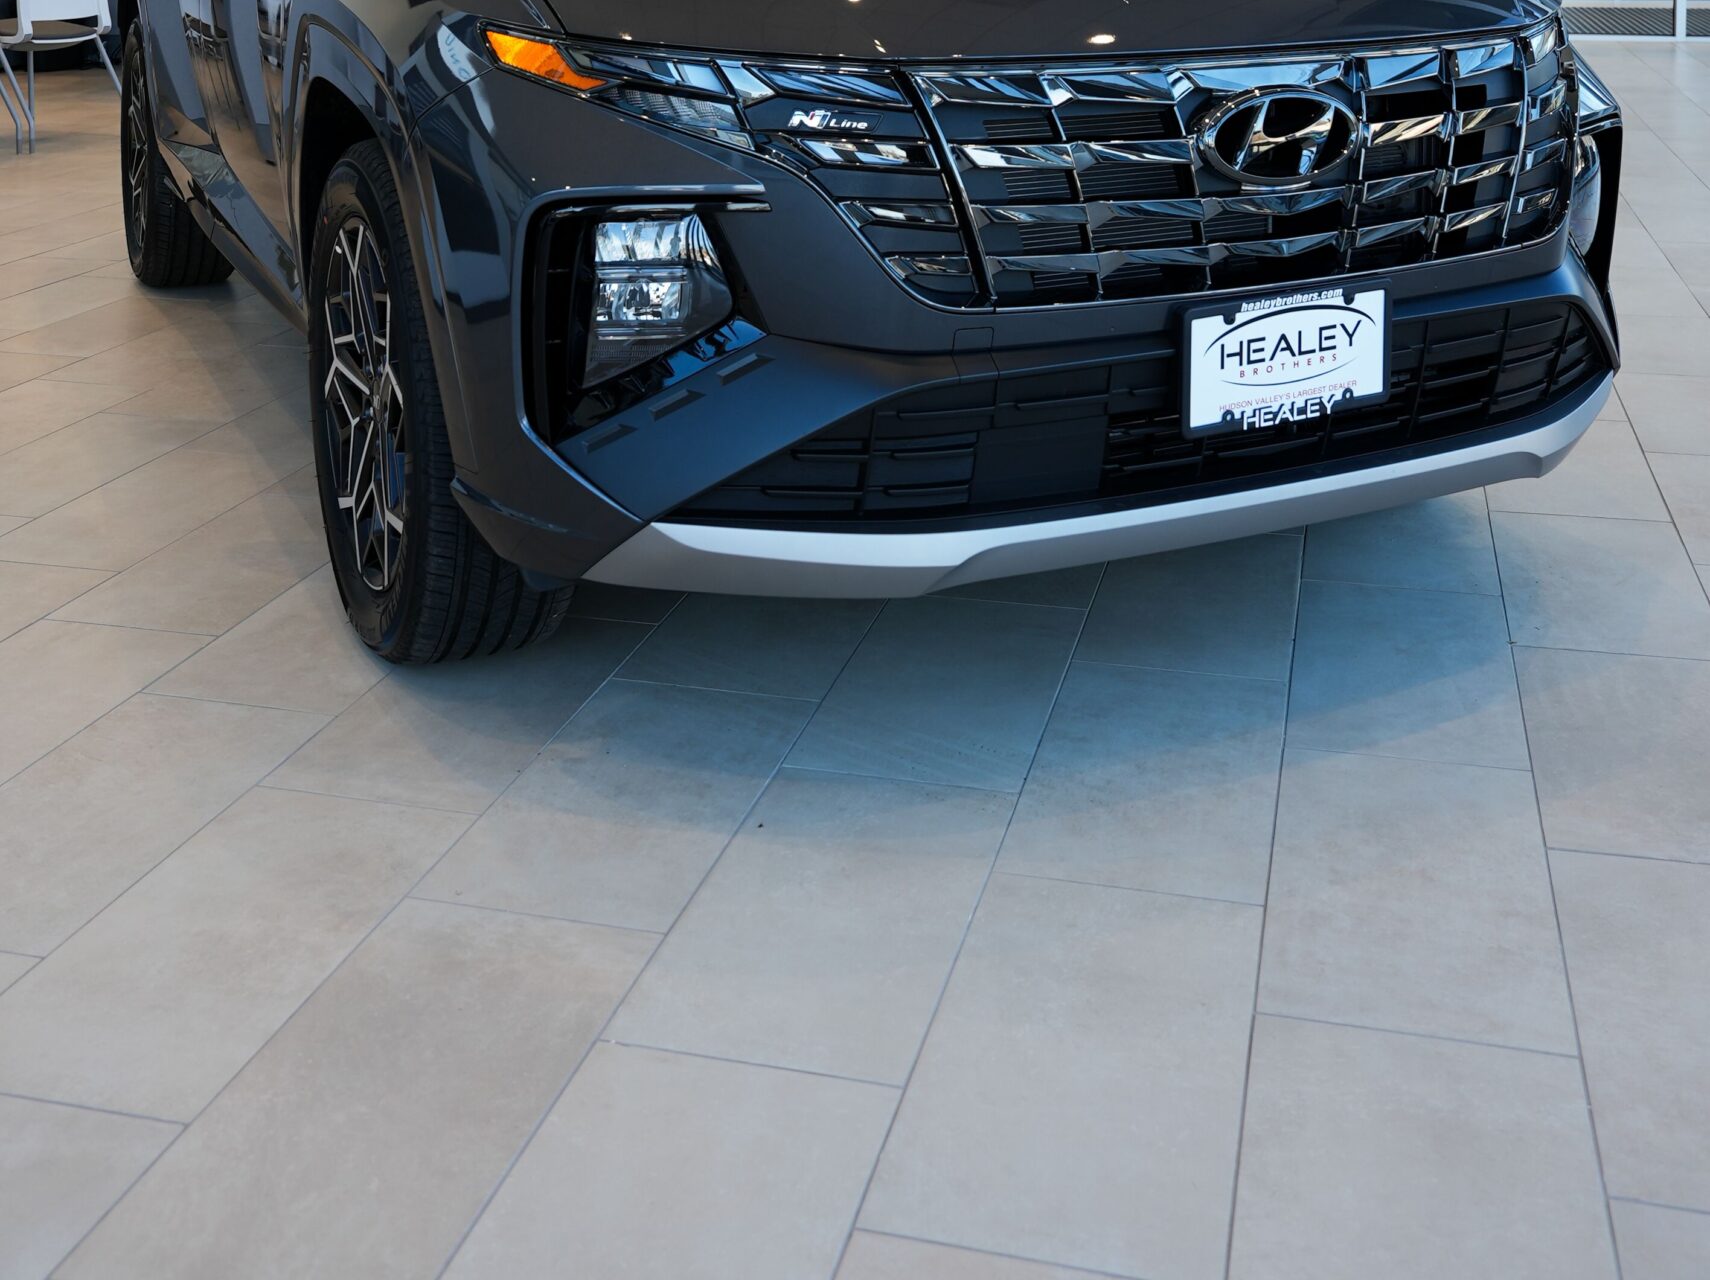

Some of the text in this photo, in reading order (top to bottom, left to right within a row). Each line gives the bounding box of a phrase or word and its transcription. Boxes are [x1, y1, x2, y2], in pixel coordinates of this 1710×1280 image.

[829, 118, 868, 130] Line
[1240, 288, 1344, 313] healeybrothers.com
[1220, 319, 1362, 370] HEALEY
[1239, 353, 1338, 379] BROTHERS
[1219, 380, 1357, 412] HUDSON VALLEY'S LARGEST DEALER
[1242, 394, 1336, 431] HEALEY
